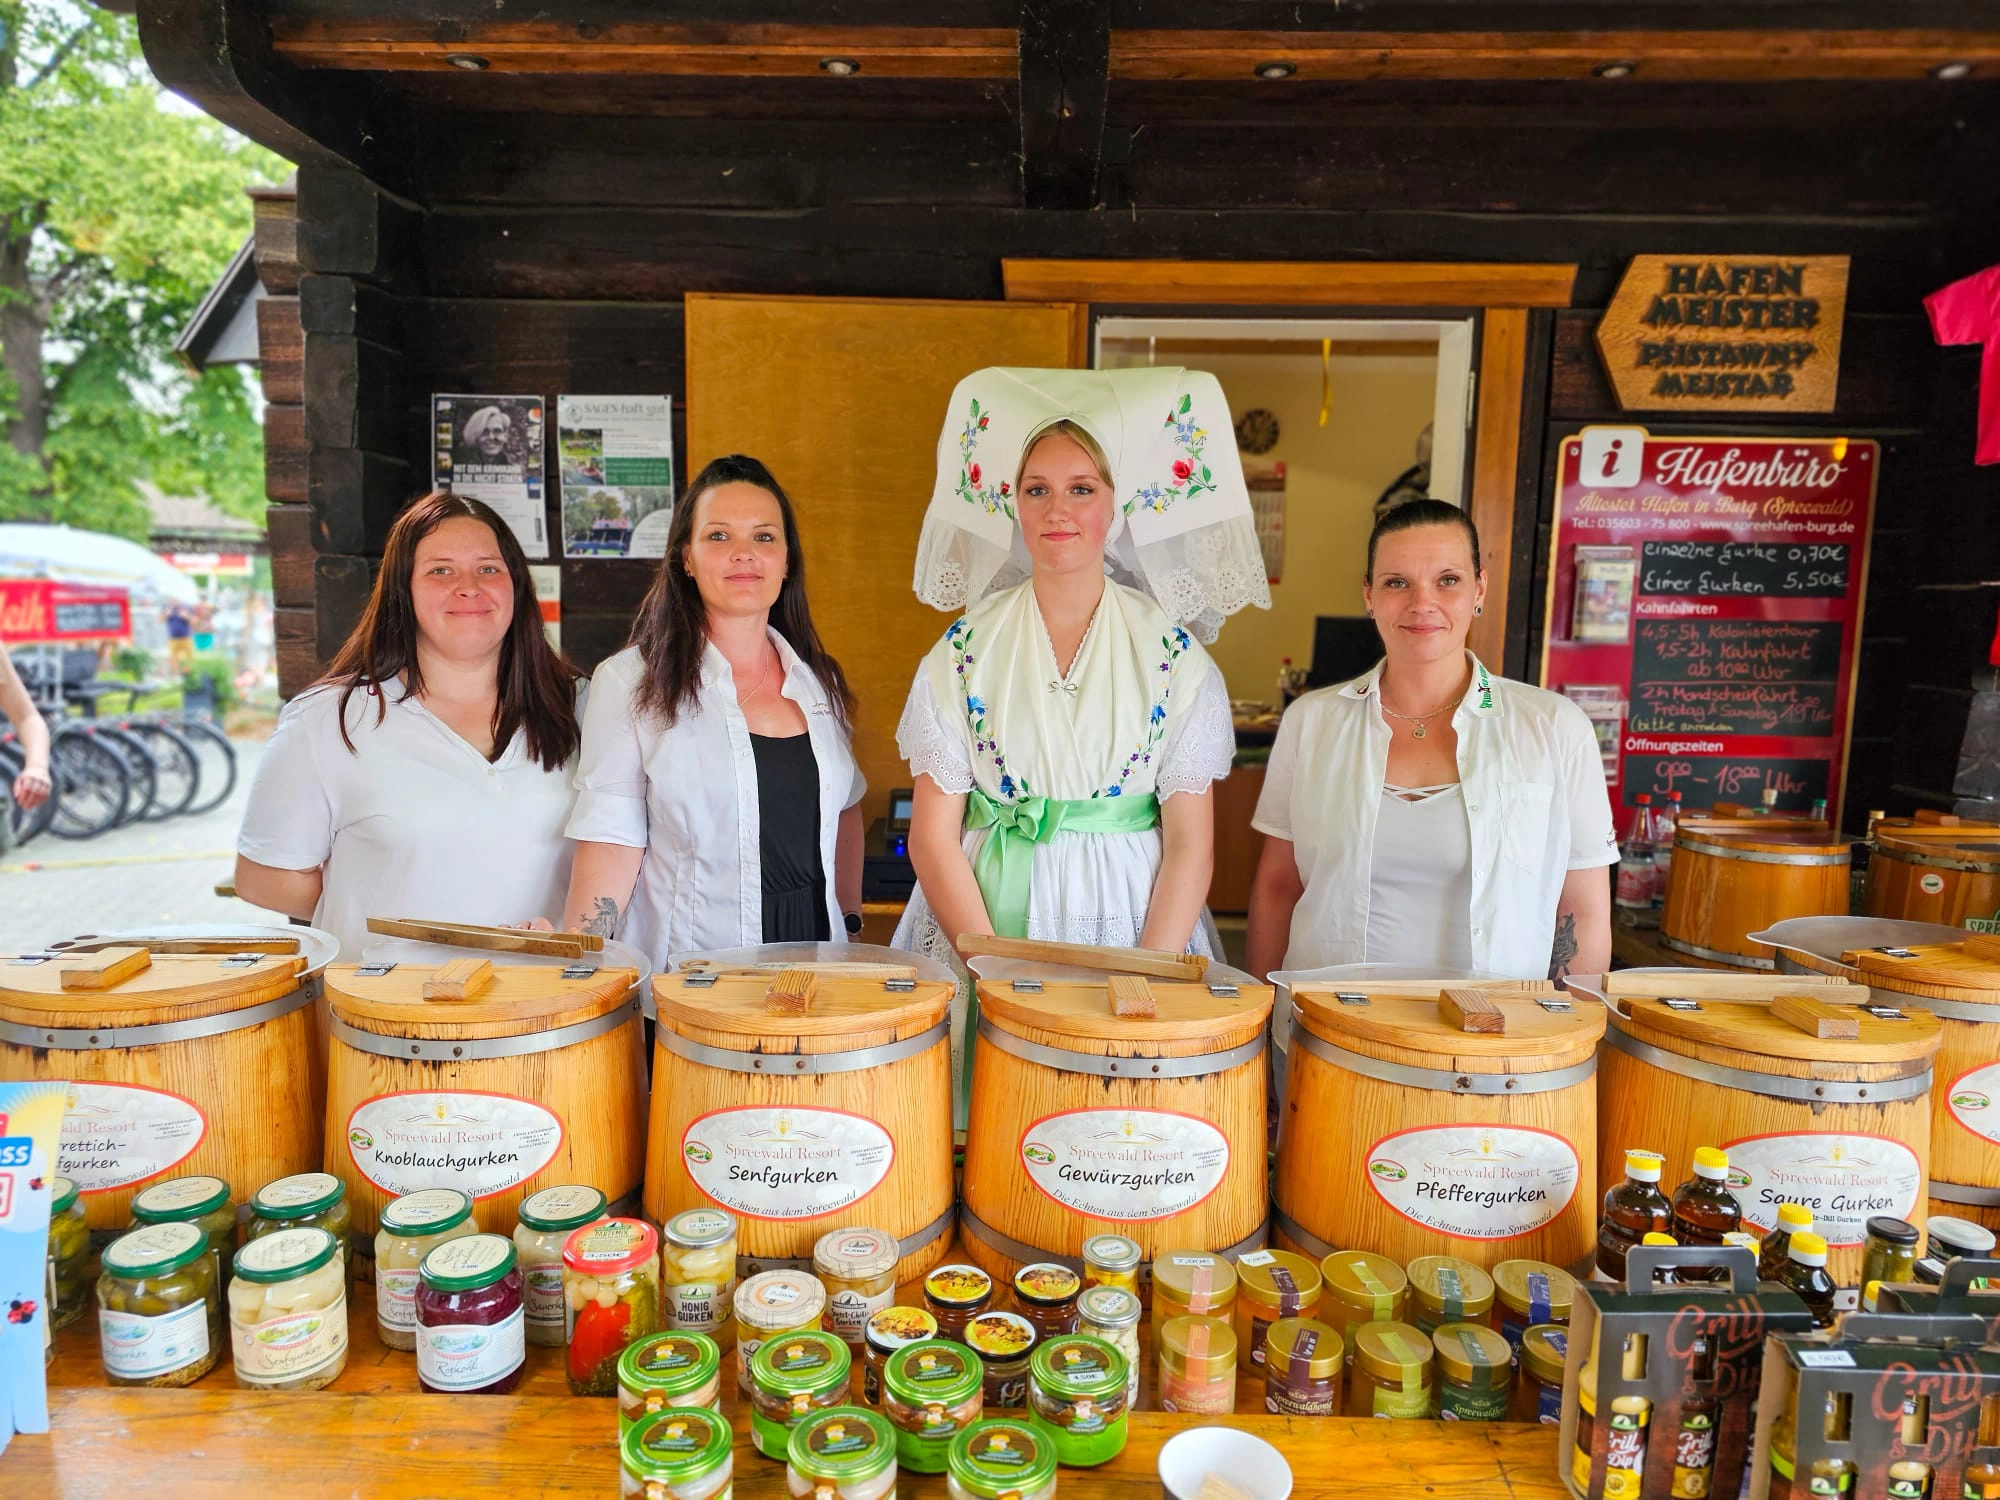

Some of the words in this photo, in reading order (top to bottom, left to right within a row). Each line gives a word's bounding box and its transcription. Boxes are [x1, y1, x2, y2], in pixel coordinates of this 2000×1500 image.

[1666, 264, 1807, 295] HAFEN
[1642, 296, 1821, 329] MEISTER
[1655, 446, 1848, 495] Hafenbüro
[1575, 493, 1636, 514] Ältester
[1643, 496, 1688, 516] Hafen
[1693, 497, 1709, 513] in
[1714, 496, 1757, 519] Burg
[1762, 497, 1854, 520] (Spreewald)
[1572, 517, 1595, 529] Tel.:
[1598, 518, 1641, 530] 035603
[1651, 518, 1666, 529] 75
[1668, 518, 1690, 530] 800
[1700, 519, 1855, 534] www.spreehafen-burg.de
[1644, 542, 1714, 558] einzelne
[1788, 545, 1846, 563] 0,70€
[1643, 571, 1692, 591] Eimer
[1698, 572, 1764, 594] Gurken
[1783, 572, 1849, 590] 5,50€
[1636, 601, 1718, 616] Kahnfahrten
[1720, 641, 1812, 664] Kahnfahrt
[1688, 663, 1711, 677] ab
[1754, 664, 1792, 680] Uhr
[1640, 686, 1669, 700] 2h
[1673, 685, 1799, 705] Mondscheinfahrt
[1649, 701, 1706, 722] Freitag
[1630, 714, 1676, 733] (bitte
[1624, 737, 1724, 754] Öffnungszeiten
[87, 1121, 137, 1134] Resort
[384, 1128, 451, 1145] Spreewald
[456, 1129, 504, 1144] Resort
[59, 1138, 128, 1152] rettich-
[725, 1142, 794, 1160] Spreewald
[797, 1146, 842, 1160] Resort
[1069, 1144, 1139, 1162] Spreewald
[1142, 1148, 1185, 1162] Resort
[375, 1149, 519, 1172] Knoblauchgurken
[1423, 1160, 1496, 1179] Spreewald
[1501, 1165, 1541, 1179] Resort
[98, 1162, 158, 1188] Spreewald
[372, 1172, 388, 1188] Die
[387, 1181, 414, 1195] Echte
[466, 1171, 521, 1198] Spreewald
[728, 1164, 839, 1189] Senfgurken
[1057, 1163, 1196, 1191] Gewürzgurken
[1769, 1167, 1846, 1187] Spreewald
[1850, 1172, 1889, 1186] Resort
[710, 1186, 727, 1202] Die
[727, 1197, 760, 1214] Echten
[761, 1206, 780, 1217] aus
[782, 1205, 804, 1217] dem
[805, 1189, 857, 1217] Spreewald
[1052, 1187, 1070, 1204] Die
[1071, 1197, 1105, 1216] Echten
[1106, 1208, 1125, 1218] aus
[1127, 1207, 1148, 1218] dem
[1150, 1191, 1199, 1217] Spreewald
[1416, 1181, 1547, 1209] Pfeffergurken
[1759, 1188, 1822, 1210] Saure
[1831, 1193, 1894, 1213] Gurken
[1403, 1205, 1423, 1221] Die
[1425, 1214, 1462, 1233] Echten
[1463, 1226, 1482, 1236] aus
[1484, 1225, 1506, 1237] dem
[1507, 1209, 1552, 1236] Spreewald
[1748, 1211, 1770, 1228] Die
[1831, 1233, 1855, 1243] dem
[1837, 1214, 1862, 1224] Gurken
[677, 1309, 714, 1324] GURKEN
[681, 1300, 710, 1313] HONIG
[1665, 1294, 1765, 1372] Grill
[435, 1358, 479, 1379] Rotkohl
[1871, 1353, 1983, 1432] Grill
[1678, 1430, 1714, 1455] Grill
[1888, 1438, 1906, 1461] &
[1607, 1453, 1634, 1471] Dip
